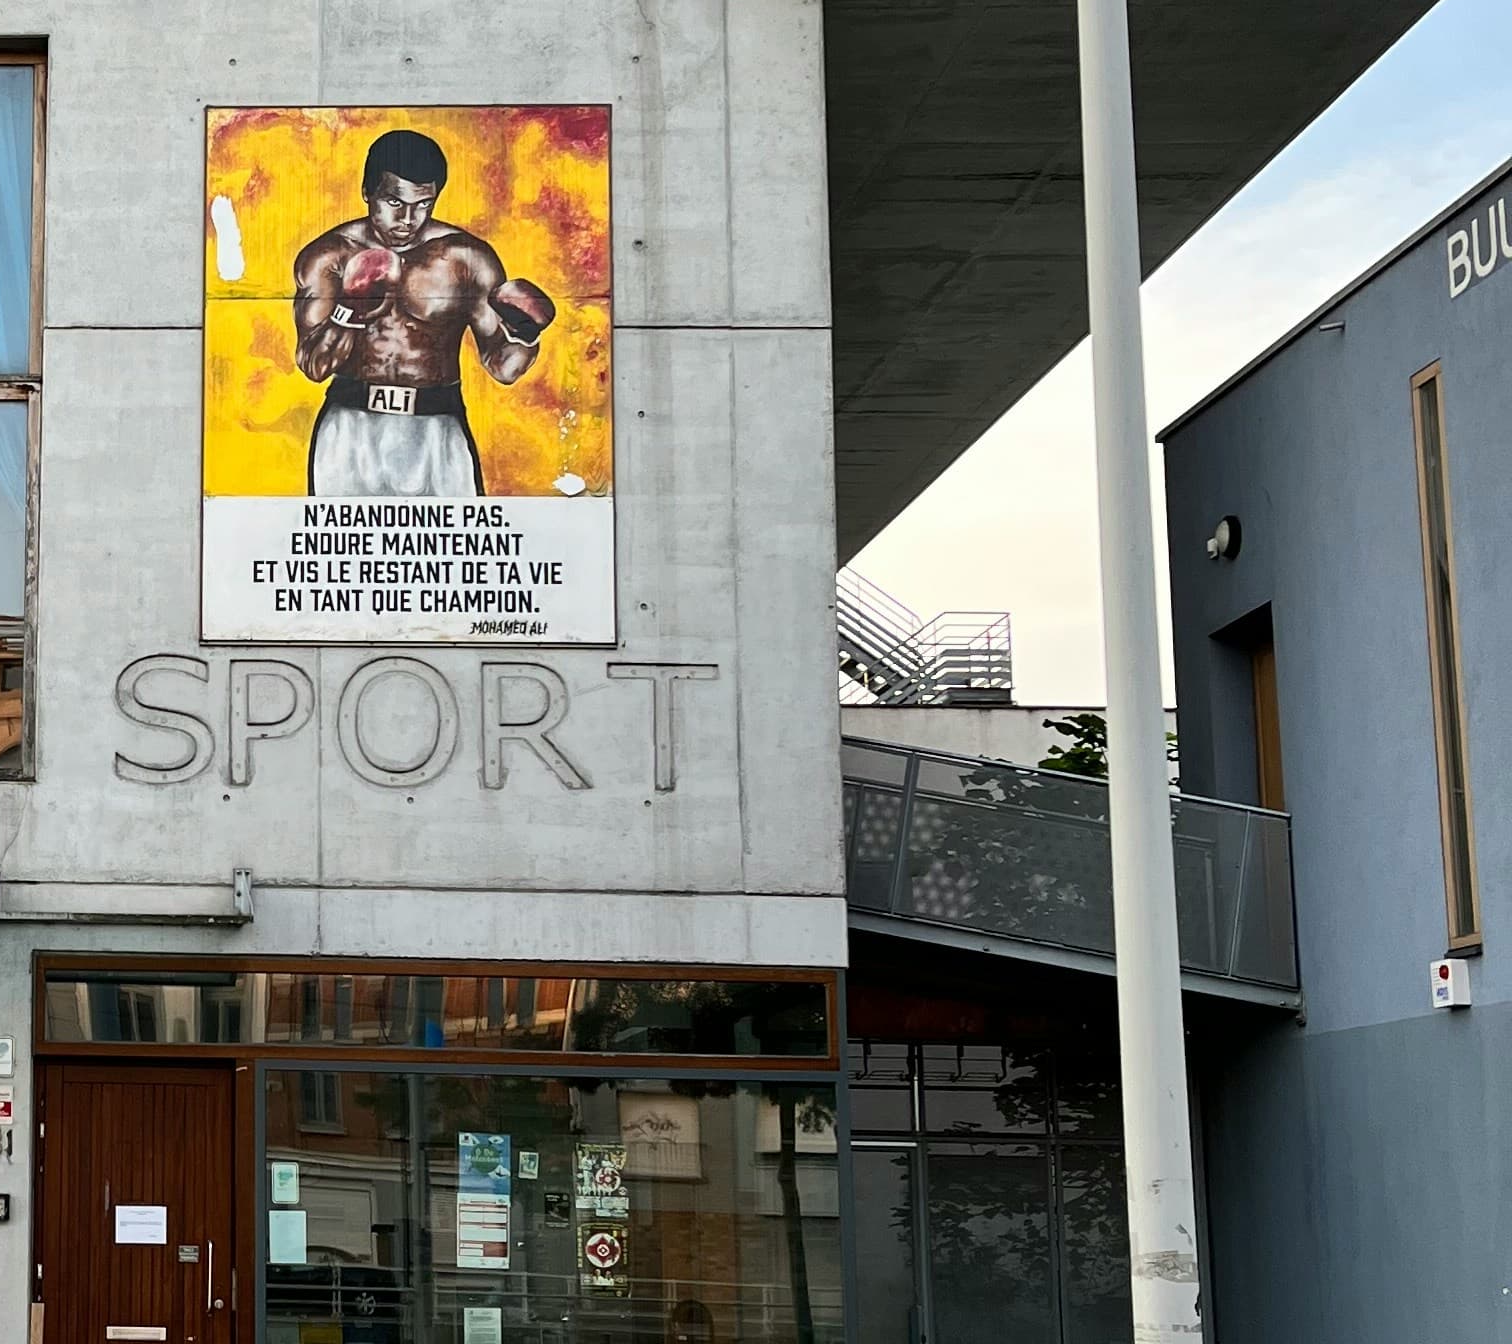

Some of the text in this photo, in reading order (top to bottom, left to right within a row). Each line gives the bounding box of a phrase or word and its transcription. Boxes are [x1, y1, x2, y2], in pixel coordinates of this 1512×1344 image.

[304, 504, 510, 527] N'ABANDONNE PAS.
[291, 532, 524, 556] ENDURE MAINTENANT
[253, 560, 563, 585] ET VIS LE RESTANT DE TA VIE
[275, 588, 541, 615] EN TANT QUE CHAMPION.
[529, 620, 548, 636] ALI
[114, 652, 719, 793] SPORT
